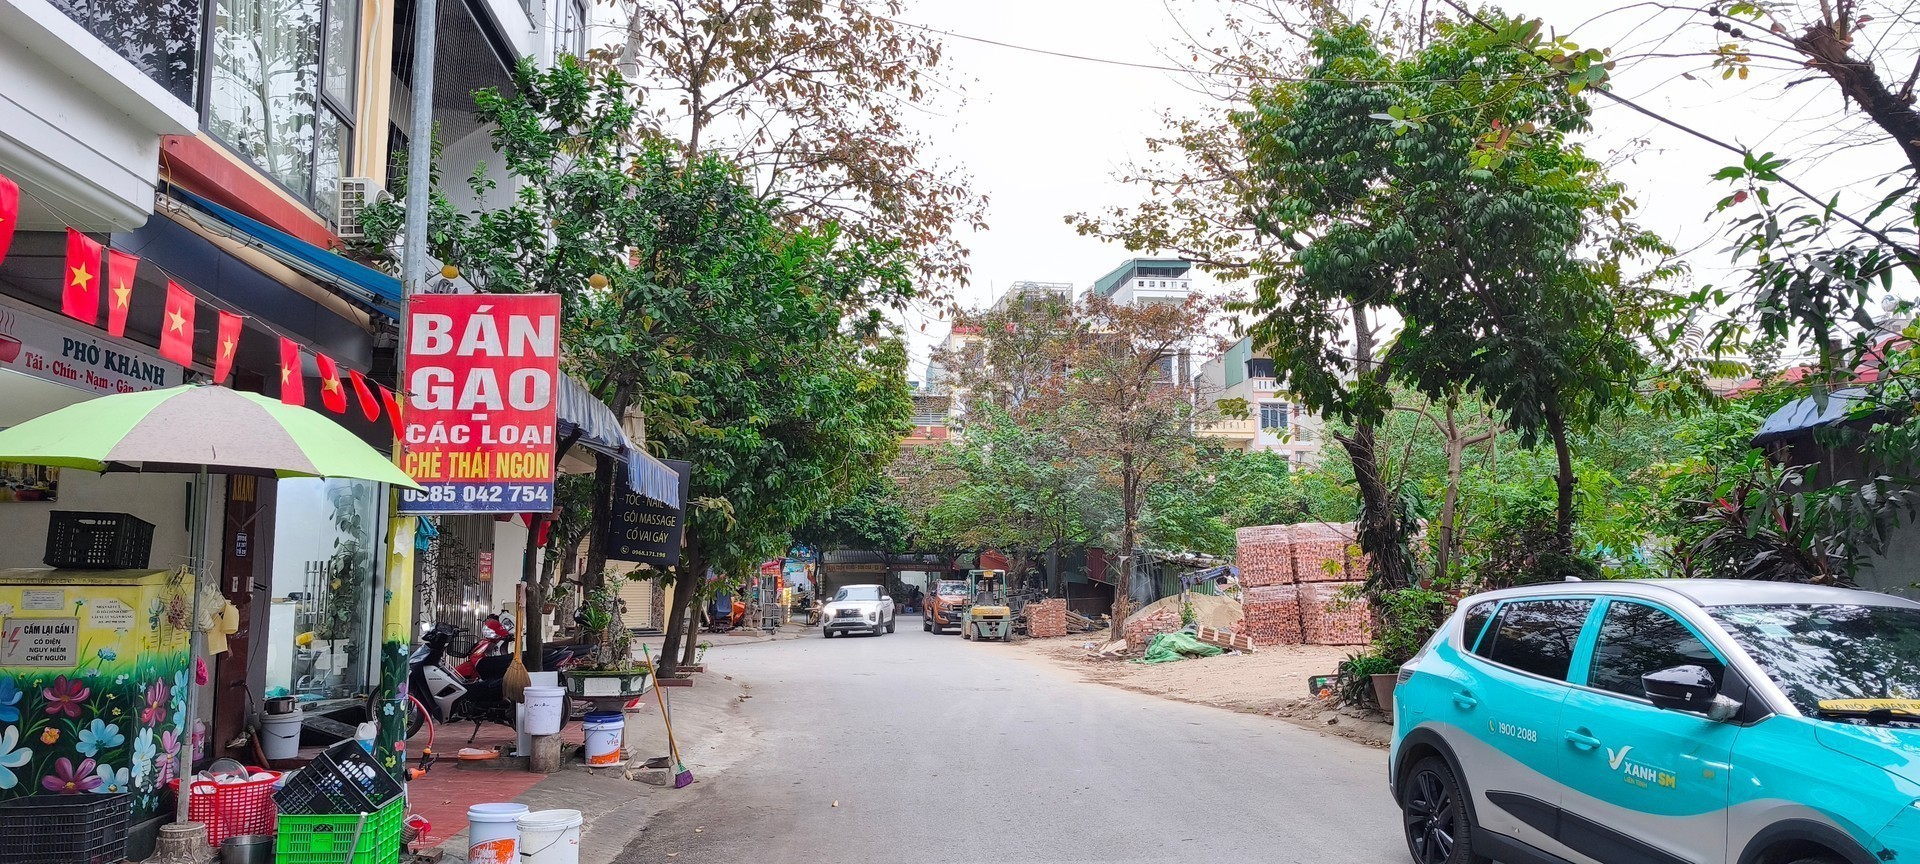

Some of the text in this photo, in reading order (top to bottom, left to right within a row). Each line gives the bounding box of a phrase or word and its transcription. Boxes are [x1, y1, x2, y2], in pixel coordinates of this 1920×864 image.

[410, 305, 556, 357] BÁN
[25, 352, 43, 371] Tái
[52, 360, 77, 381] Chín
[86, 370, 108, 390] Nạm
[62, 337, 166, 387] PHỞ KHÁNH
[411, 366, 551, 420] GẠO
[405, 421, 552, 448] CÁC LOẠI
[405, 446, 549, 479] CHÈ THÁI NGON
[463, 486, 502, 502] 042
[508, 486, 548, 502] 754
[625, 493, 641, 506] TÓC
[639, 513, 676, 527] MASSAGE
[639, 530, 652, 542] VAI
[652, 530, 669, 543] GÁY
[24, 623, 40, 635] CẤM
[42, 625, 54, 636] LẠI
[45, 637, 61, 646] ĐIỆN
[26, 653, 67, 661] CHẾT NGƯỜI
[1498, 721, 1537, 743] 1900 2088
[1623, 761, 1676, 789] XANH SM
